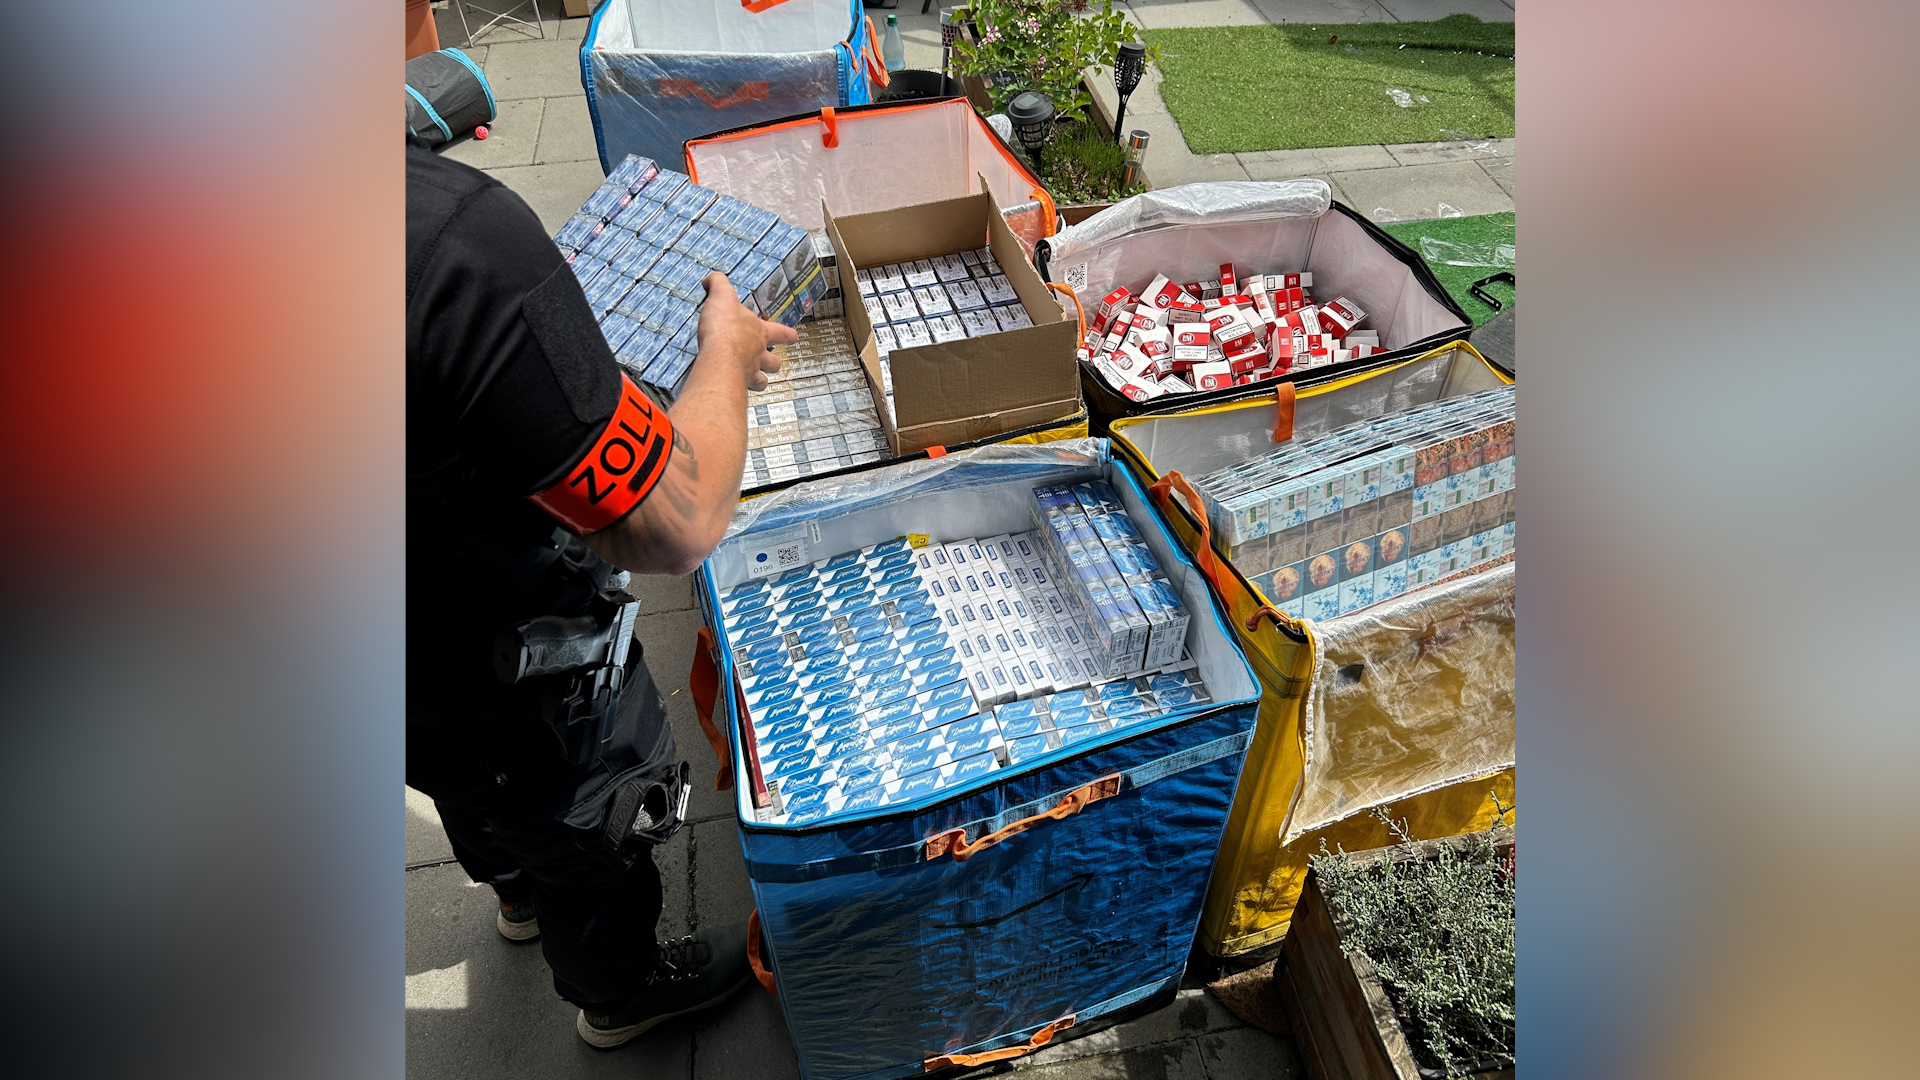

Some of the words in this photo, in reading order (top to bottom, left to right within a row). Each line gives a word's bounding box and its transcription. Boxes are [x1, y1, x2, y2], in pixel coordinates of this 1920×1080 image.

[1220, 325, 1246, 337] SMOKING
[569, 395, 653, 506] ZOLL
[753, 564, 774, 574] 0196
[988, 960, 1053, 988] Amazon
